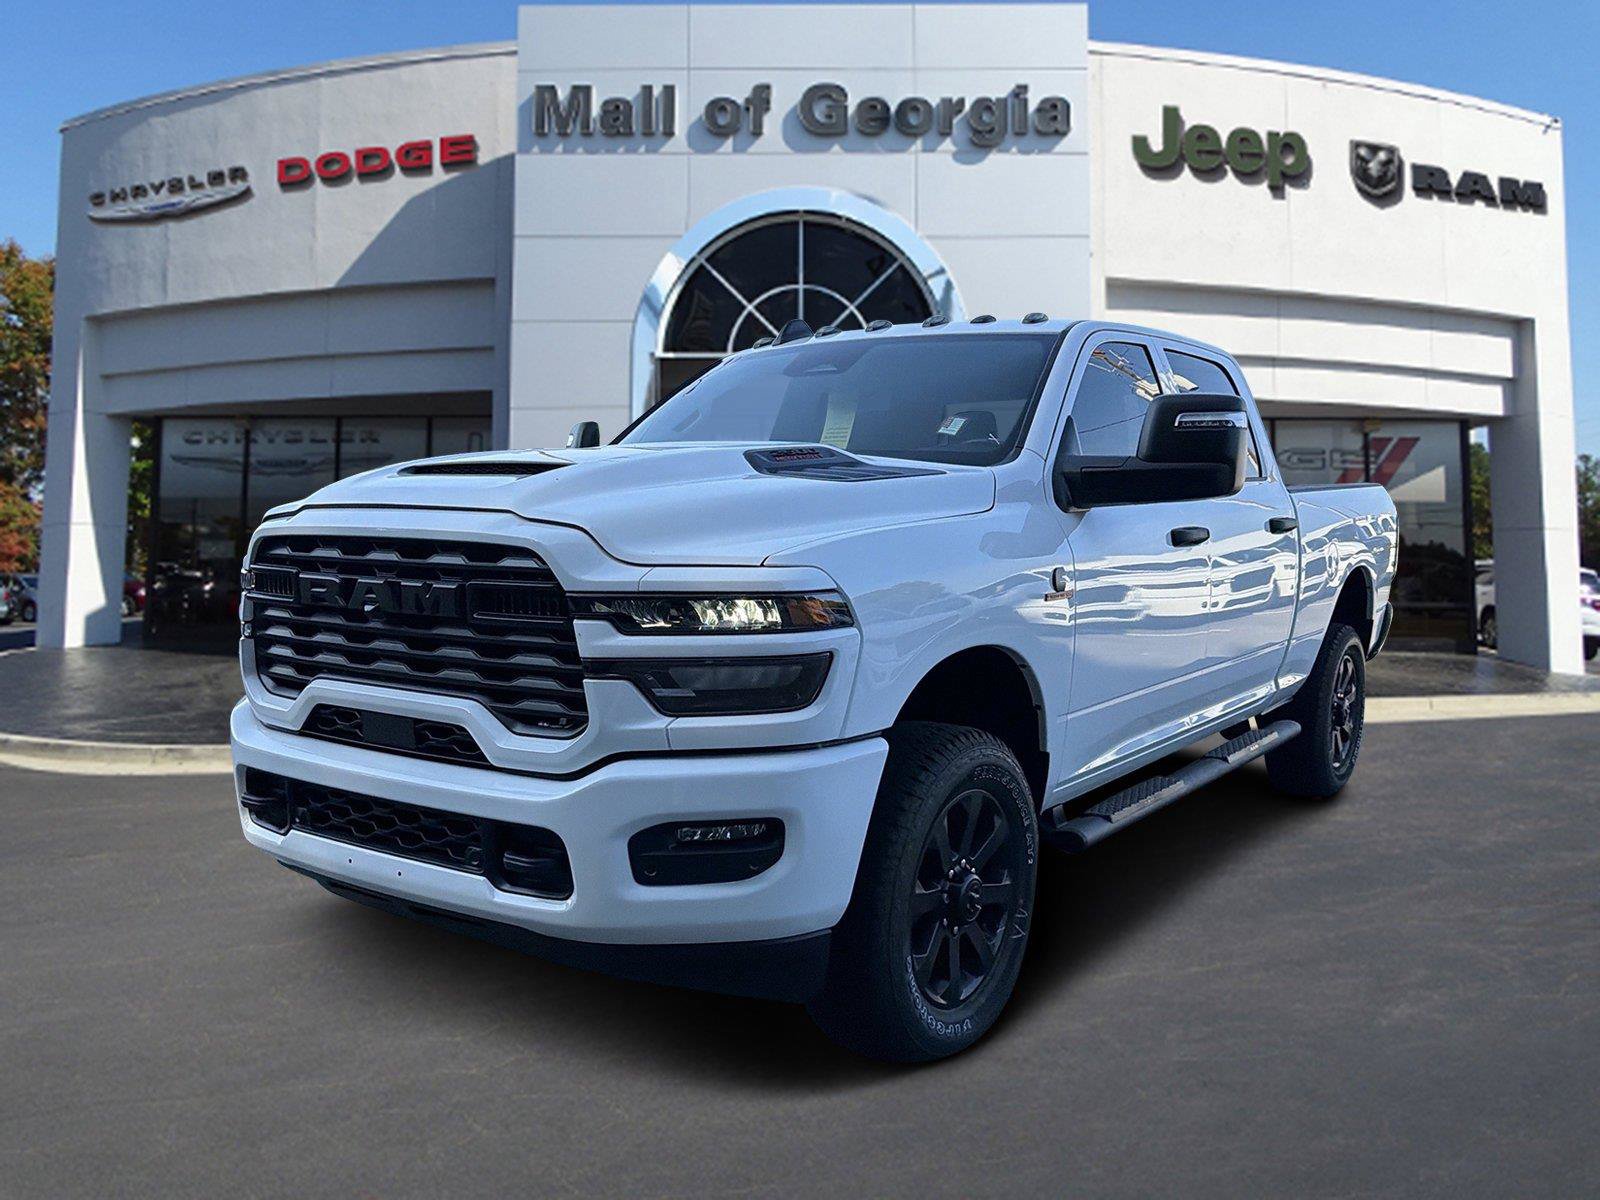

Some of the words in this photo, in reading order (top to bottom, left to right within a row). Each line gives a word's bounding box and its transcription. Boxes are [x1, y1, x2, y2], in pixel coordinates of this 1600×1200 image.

[534, 84, 677, 137] Mall
[704, 84, 773, 137] of
[799, 82, 1072, 147] Georgia
[278, 134, 477, 187] DODGE
[1132, 105, 1309, 191] Jeep
[89, 166, 248, 206] CHRYSLER
[1411, 163, 1547, 212] RAM
[183, 428, 380, 445] CHRYSLER
[300, 573, 460, 616] RAM
